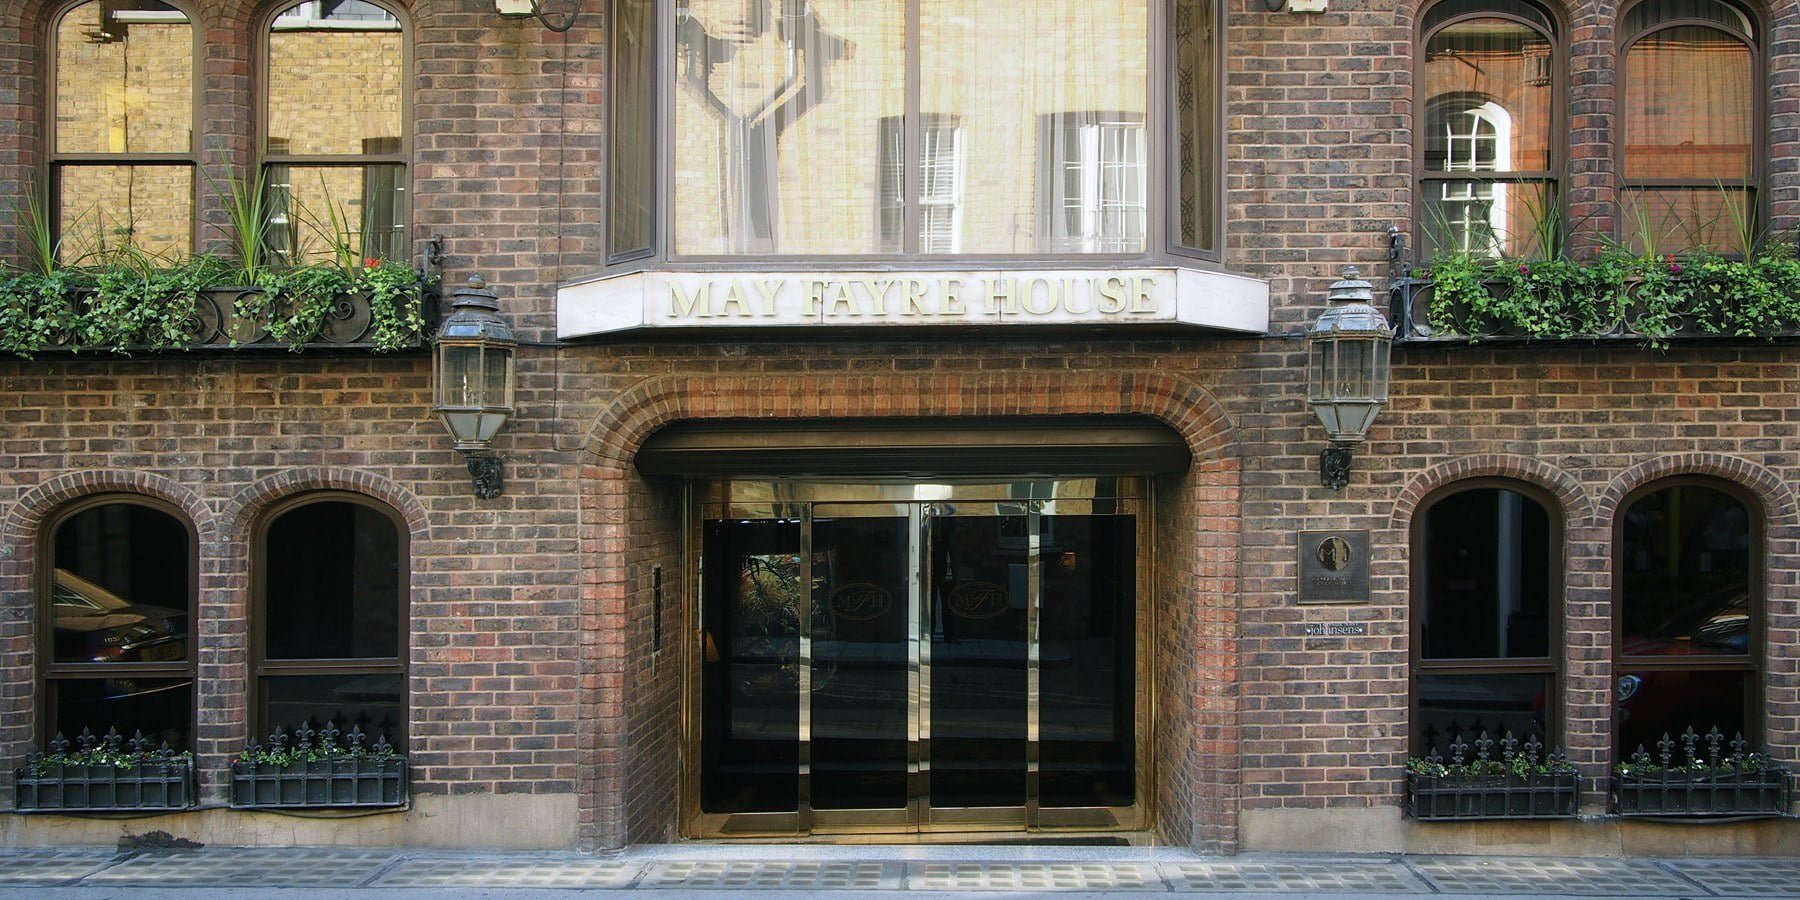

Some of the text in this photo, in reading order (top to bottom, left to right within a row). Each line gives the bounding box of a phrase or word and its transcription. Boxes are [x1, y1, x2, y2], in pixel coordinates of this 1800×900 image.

[666, 276, 1158, 318] MAY FAYRE HOUSE
